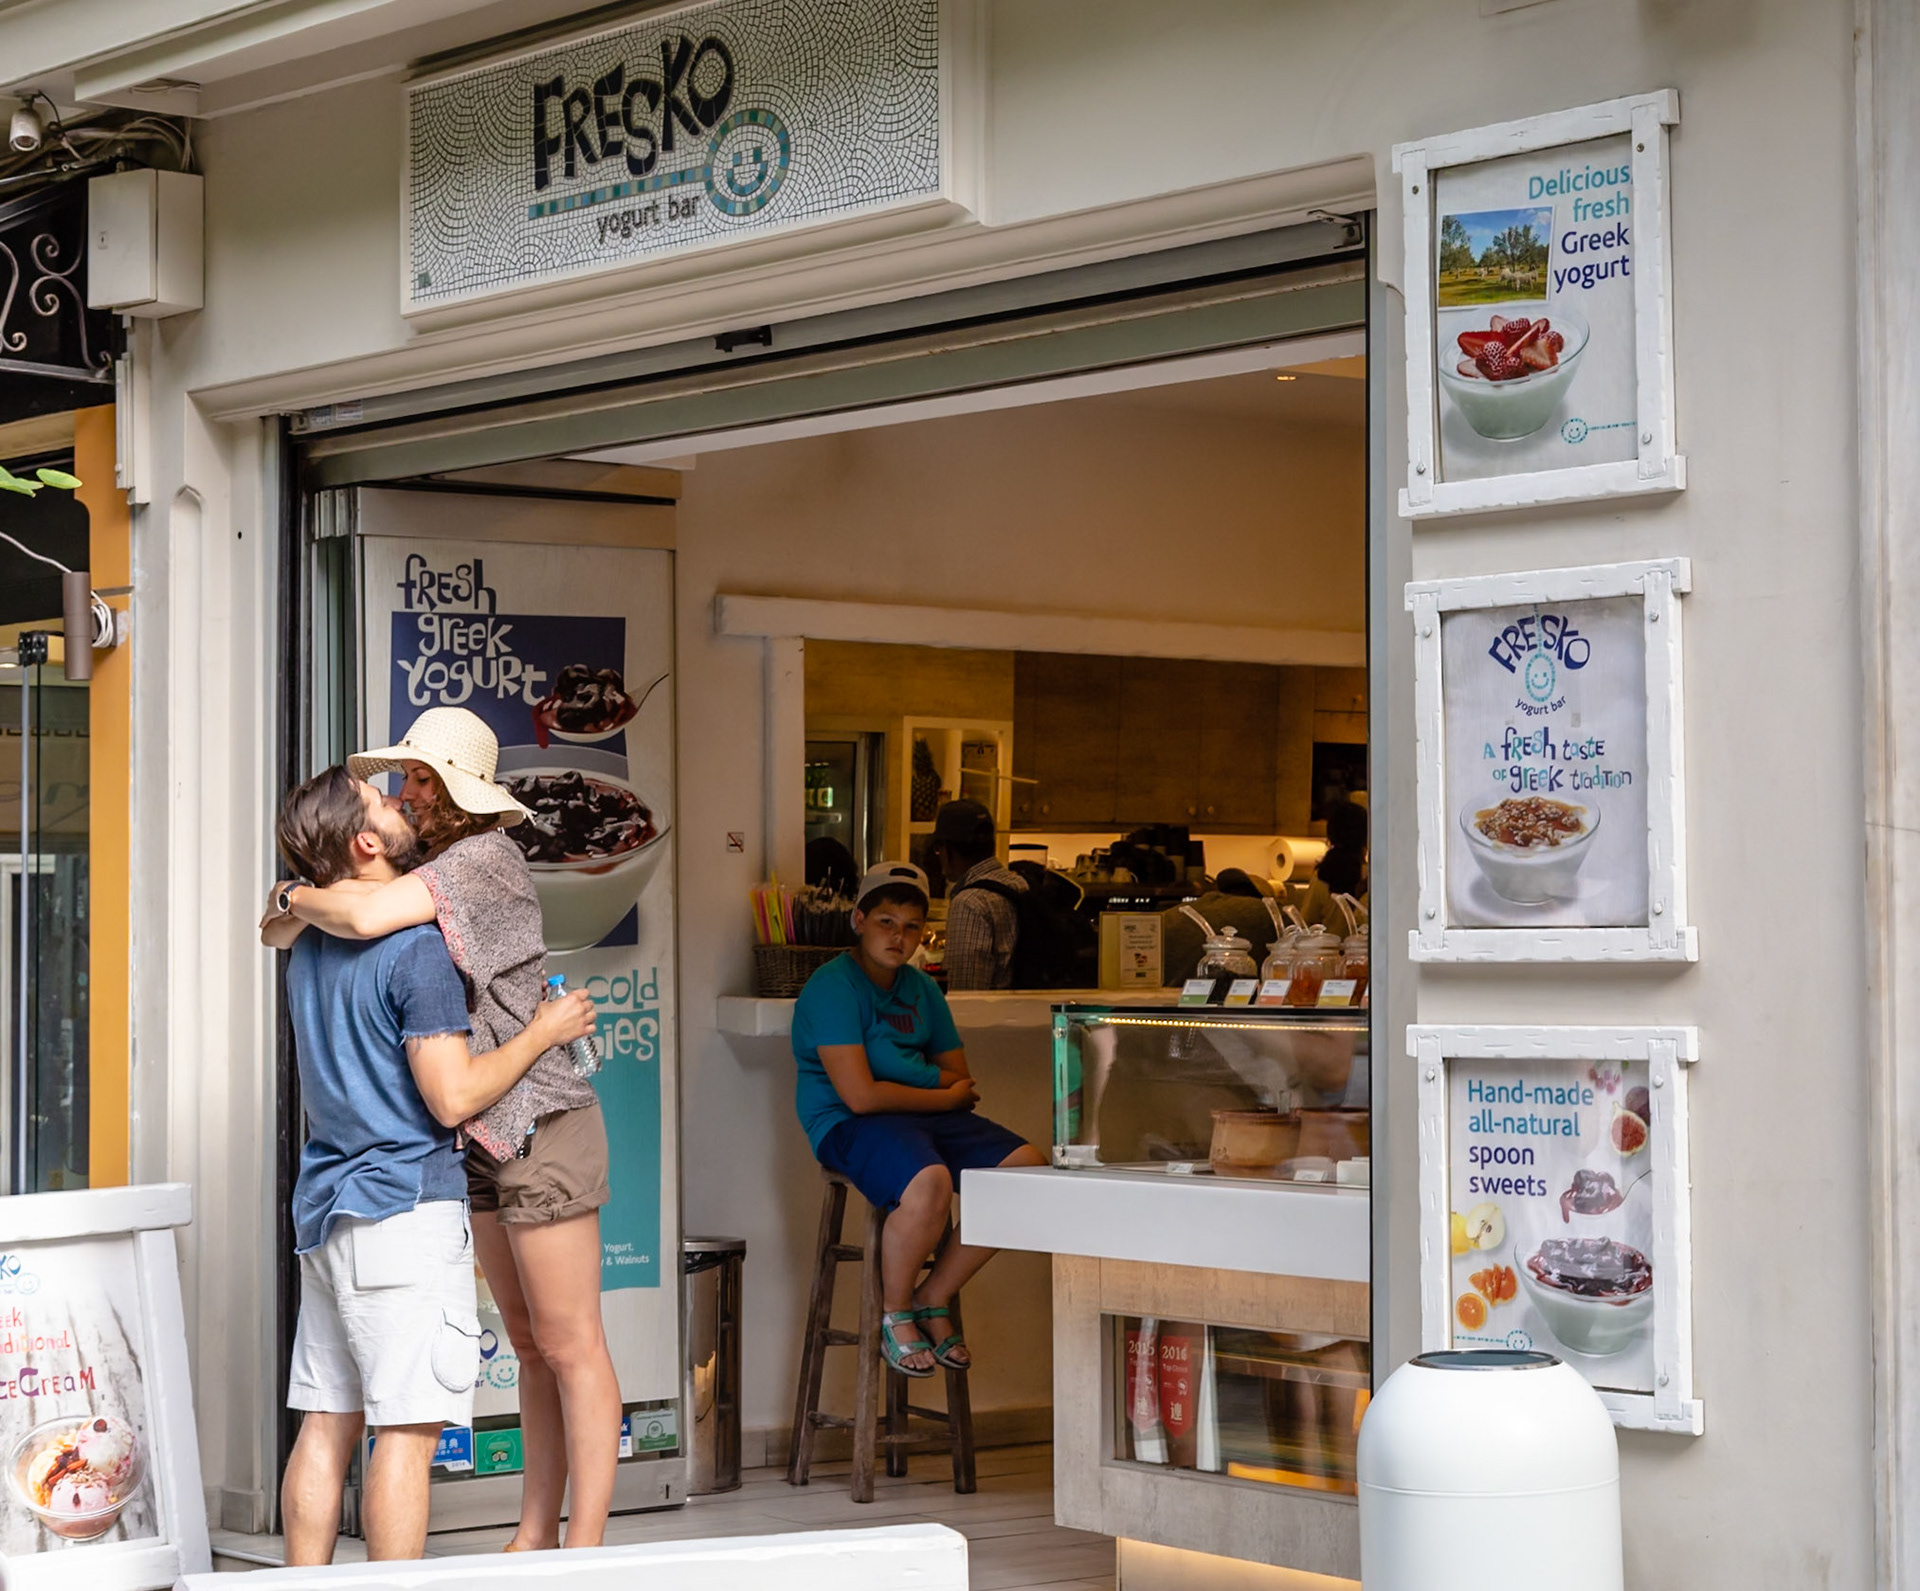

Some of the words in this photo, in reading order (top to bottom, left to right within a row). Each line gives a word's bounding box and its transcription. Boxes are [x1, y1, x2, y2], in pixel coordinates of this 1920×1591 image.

[534, 35, 734, 192] FRESKO
[595, 201, 660, 244] yogurt
[667, 195, 700, 221] bar
[1573, 190, 1630, 222] fresh
[1562, 221, 1630, 255] Greek
[1554, 254, 1630, 293] yogurt
[1488, 614, 1591, 673] FRESKO
[1515, 697, 1549, 716] yogurt
[1551, 695, 1567, 711] bar
[1483, 742, 1496, 759] A
[1468, 1079, 1594, 1106] Hand-made
[1468, 1109, 1580, 1137] all-natural
[1469, 1144, 1534, 1169] spoon
[1469, 1173, 1547, 1196] sweets
[604, 1242, 634, 1255] Yogurt.
[606, 1256, 613, 1266] &
[615, 1255, 650, 1265] Walnuts
